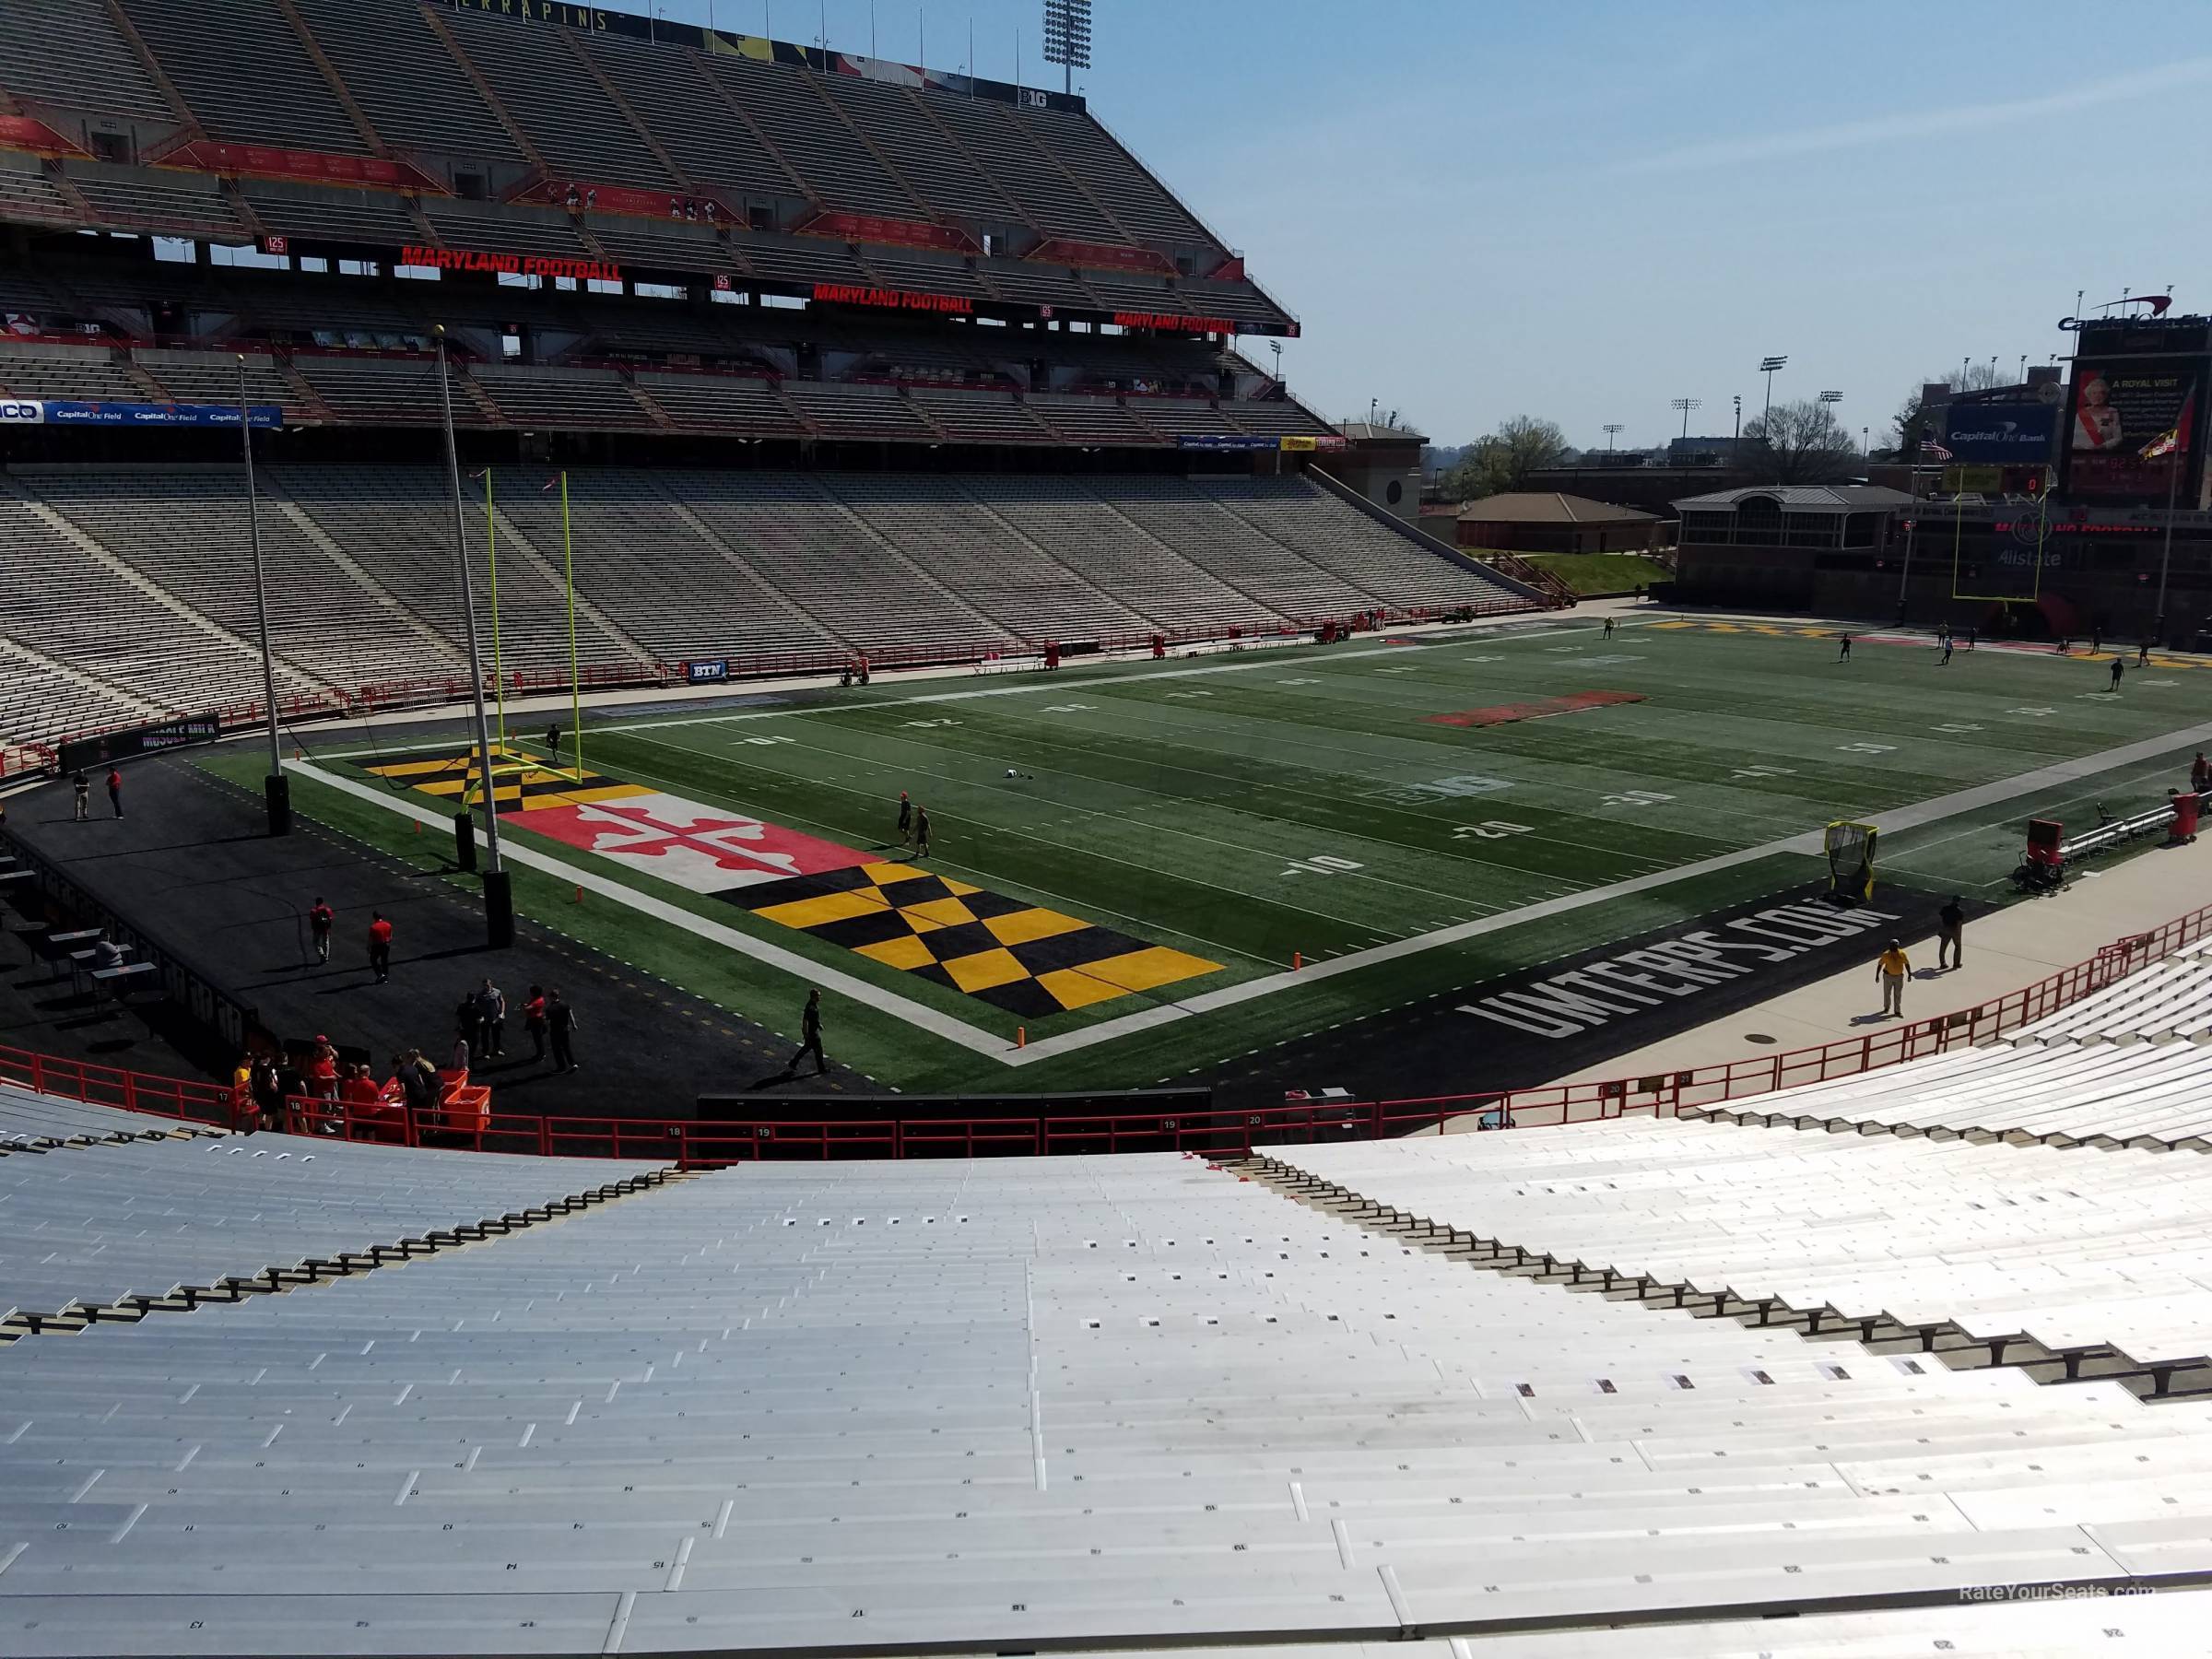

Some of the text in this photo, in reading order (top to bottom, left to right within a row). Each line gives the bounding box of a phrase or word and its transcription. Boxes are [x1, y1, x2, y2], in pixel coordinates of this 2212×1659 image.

[401, 246, 623, 281] MARYLAND FOOTBALL
[812, 282, 974, 314] MARYLAND FOOTBALL
[1112, 312, 1237, 335] MARYLAND FOOTBALL
[2112, 378, 2178, 388] A ROYAL VISIT
[105, 411, 123, 420] Field
[181, 413, 198, 422] Field
[253, 415, 271, 423] Field
[2018, 433, 2046, 442] Bank
[2029, 478, 2037, 490] 0
[1997, 548, 2062, 567] Allstte
[693, 665, 722, 677] BTN
[1835, 742, 1899, 754] 50
[1730, 765, 1799, 778] 40
[1599, 790, 1677, 806] 30
[1452, 820, 1535, 839] 20
[1286, 855, 1365, 875] 10
[1454, 897, 1903, 1039] UMTERPS.COM
[219, 1092, 228, 1101] 17
[290, 1101, 301, 1111] 18
[1164, 1120, 1175, 1129] 19
[1249, 1116, 1261, 1124] 20
[668, 1127, 680, 1136] 18
[758, 1128, 770, 1136] 19
